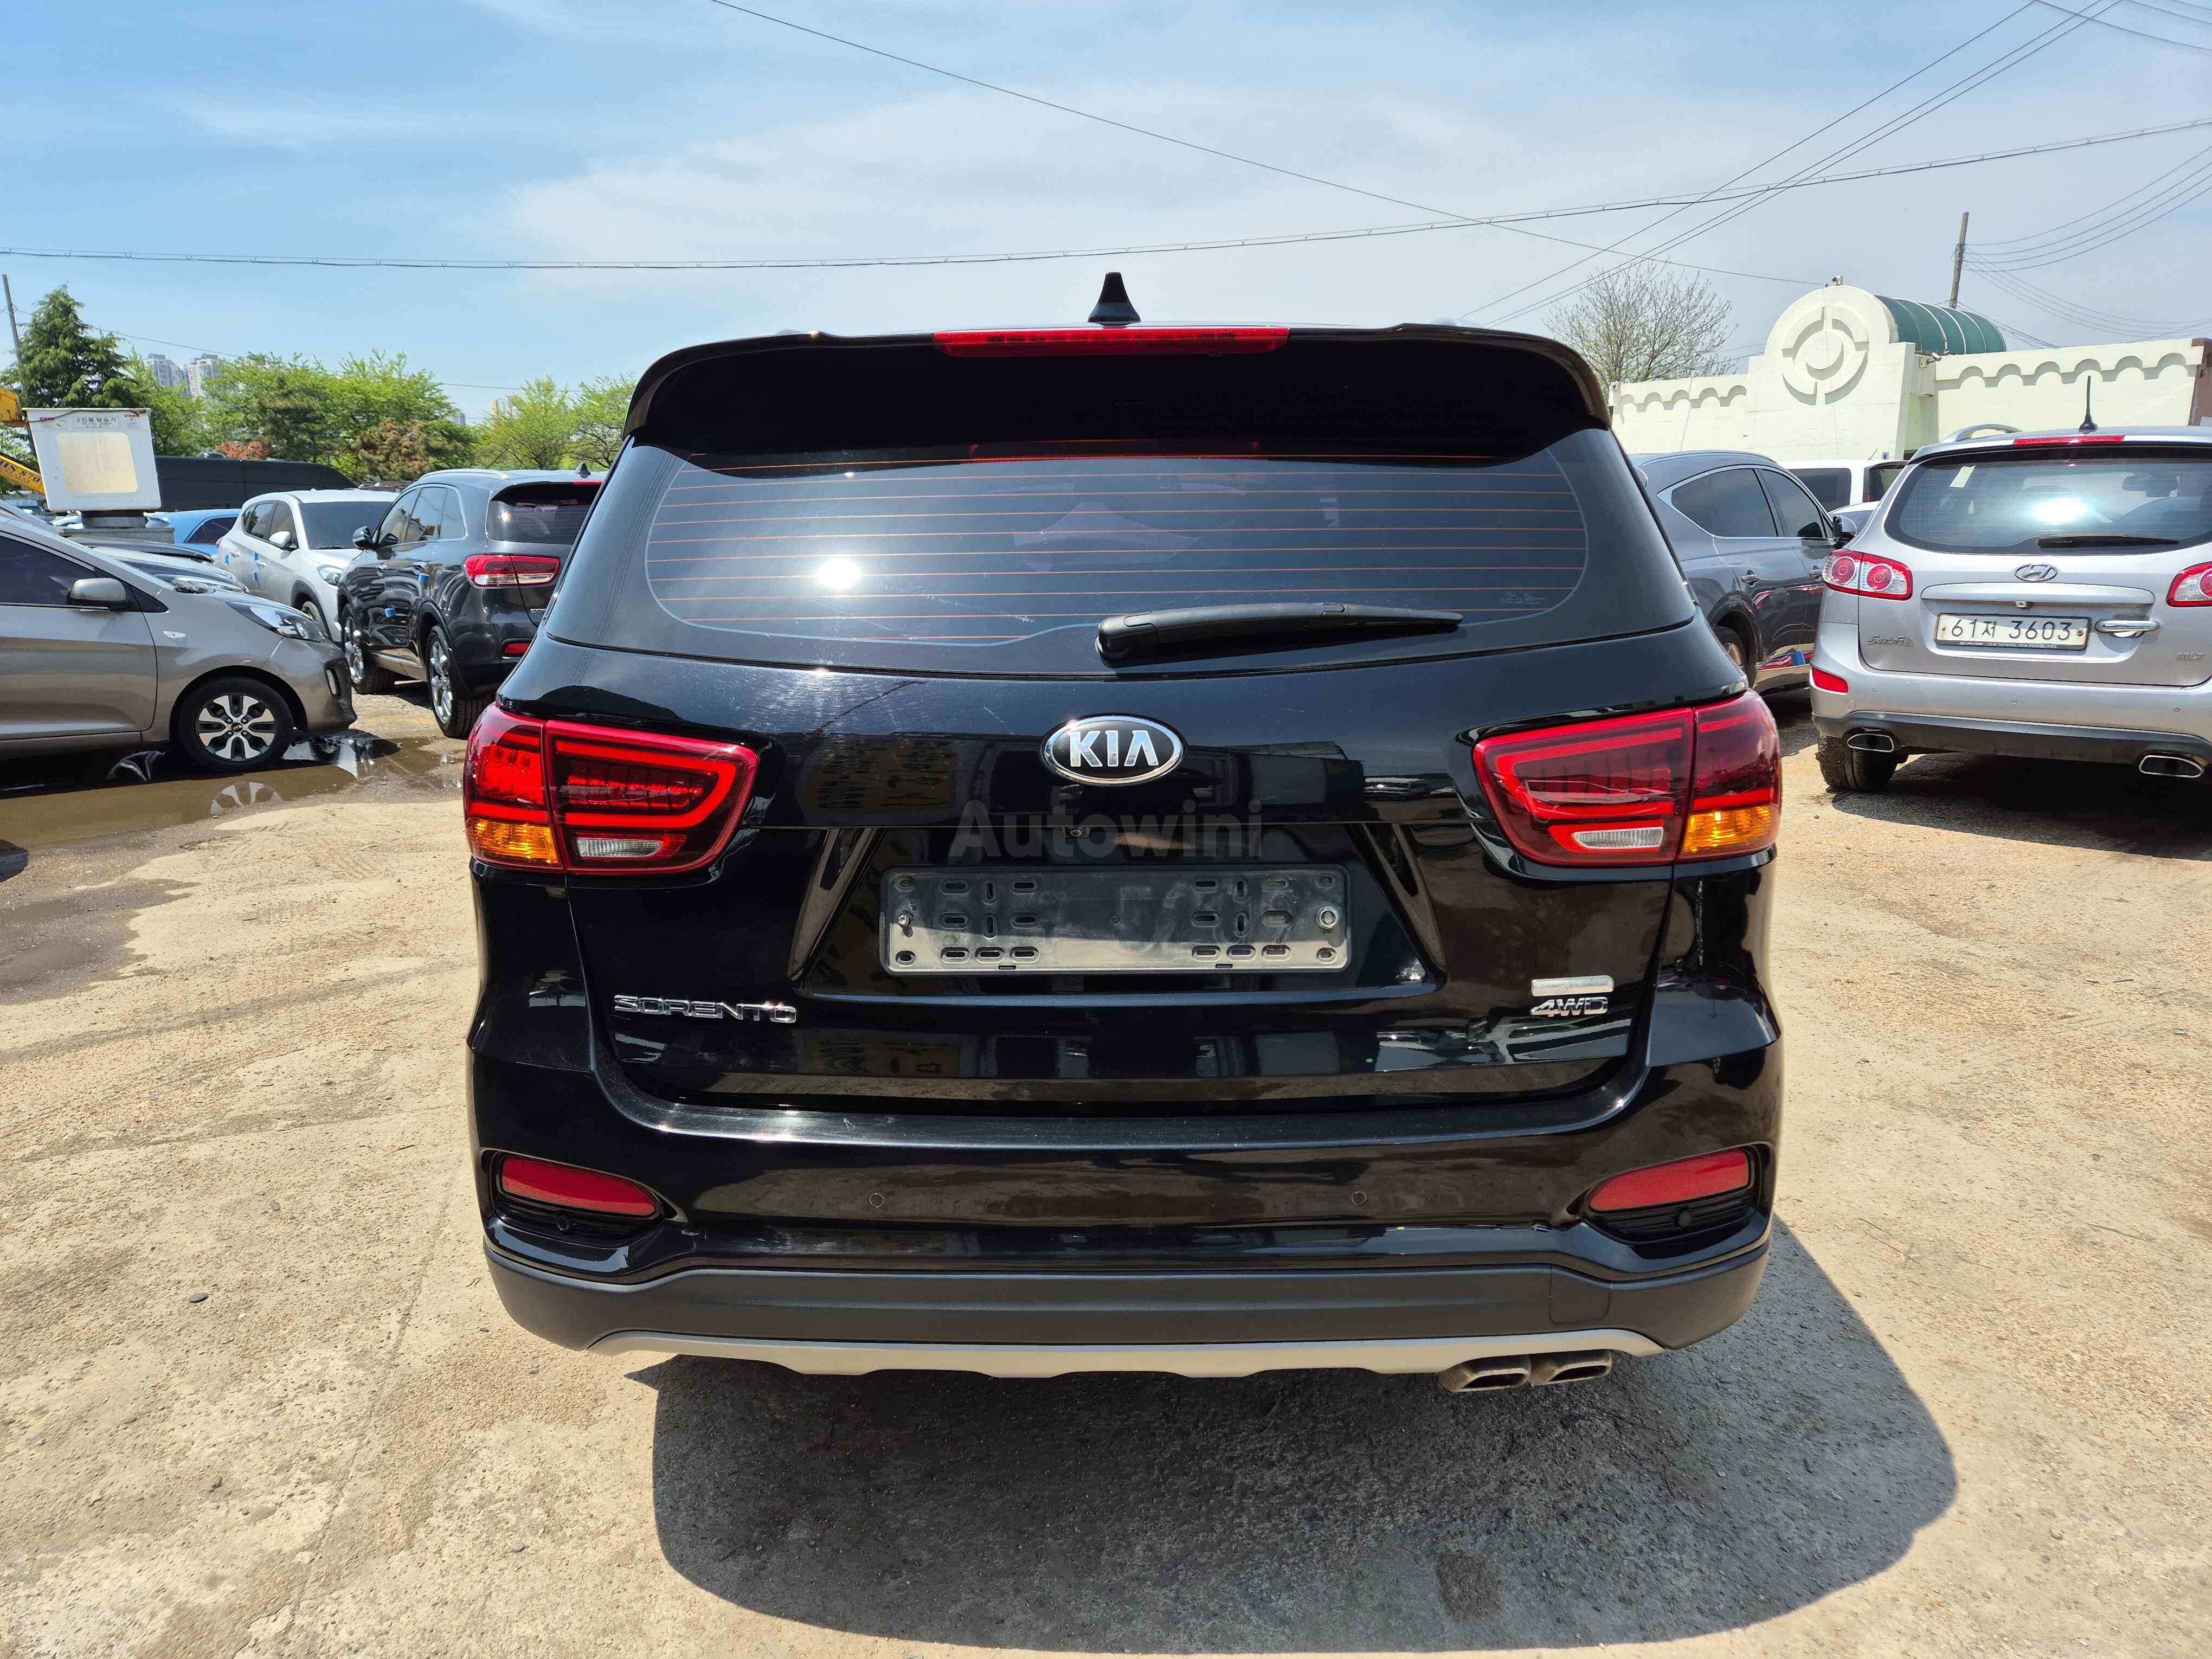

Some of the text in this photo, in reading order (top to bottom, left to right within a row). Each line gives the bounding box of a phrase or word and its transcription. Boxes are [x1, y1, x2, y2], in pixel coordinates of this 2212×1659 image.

[1951, 619, 2073, 641] 61저 3603
[1069, 729, 1160, 768] KIA
[614, 994, 797, 1024] SORENTO
[1530, 996, 1609, 1018] 4WD
